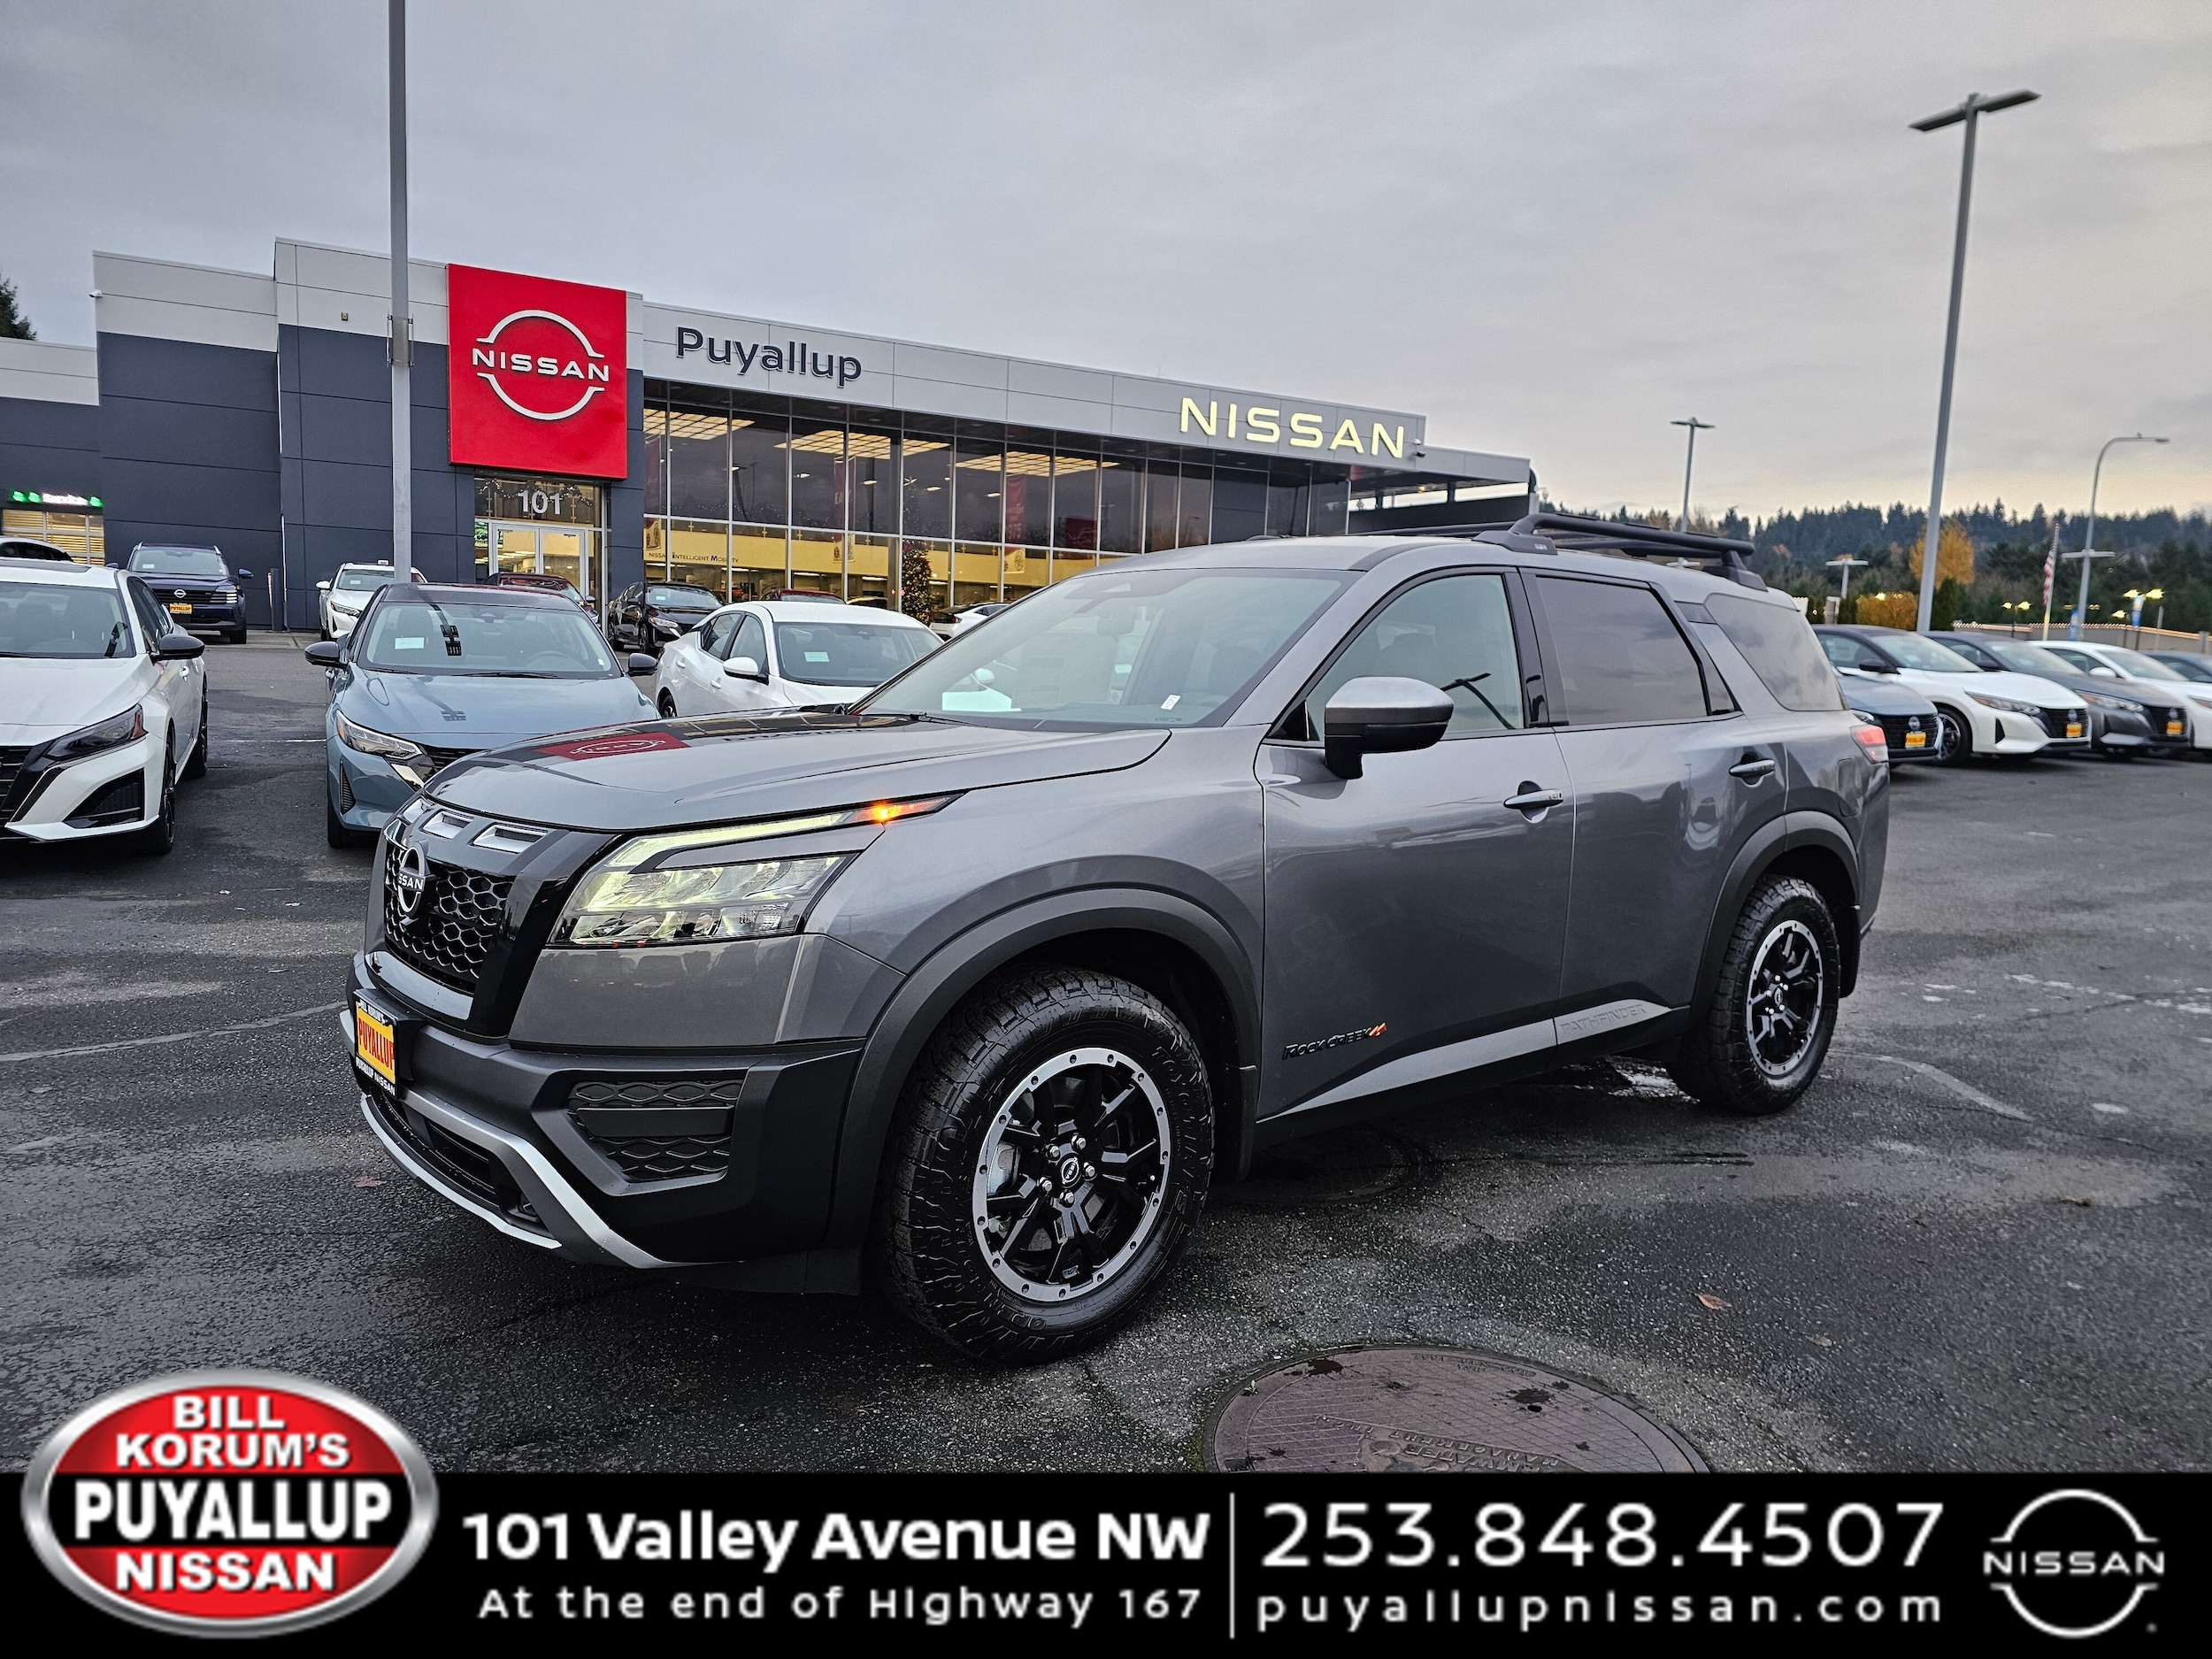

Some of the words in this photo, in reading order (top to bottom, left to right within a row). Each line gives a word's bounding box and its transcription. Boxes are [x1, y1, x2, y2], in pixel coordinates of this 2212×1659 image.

[472, 348, 610, 382] NISSAN
[676, 326, 863, 388] Puyallup
[1179, 397, 1404, 458] NISSAN
[518, 489, 563, 515] 101
[1006, 523, 1022, 540] 975
[398, 872, 424, 890] SSAN
[1560, 1003, 1647, 1034] PATHFINDER
[358, 1018, 396, 1071] PUYALLUP
[1281, 1039, 1326, 1060] ROCK
